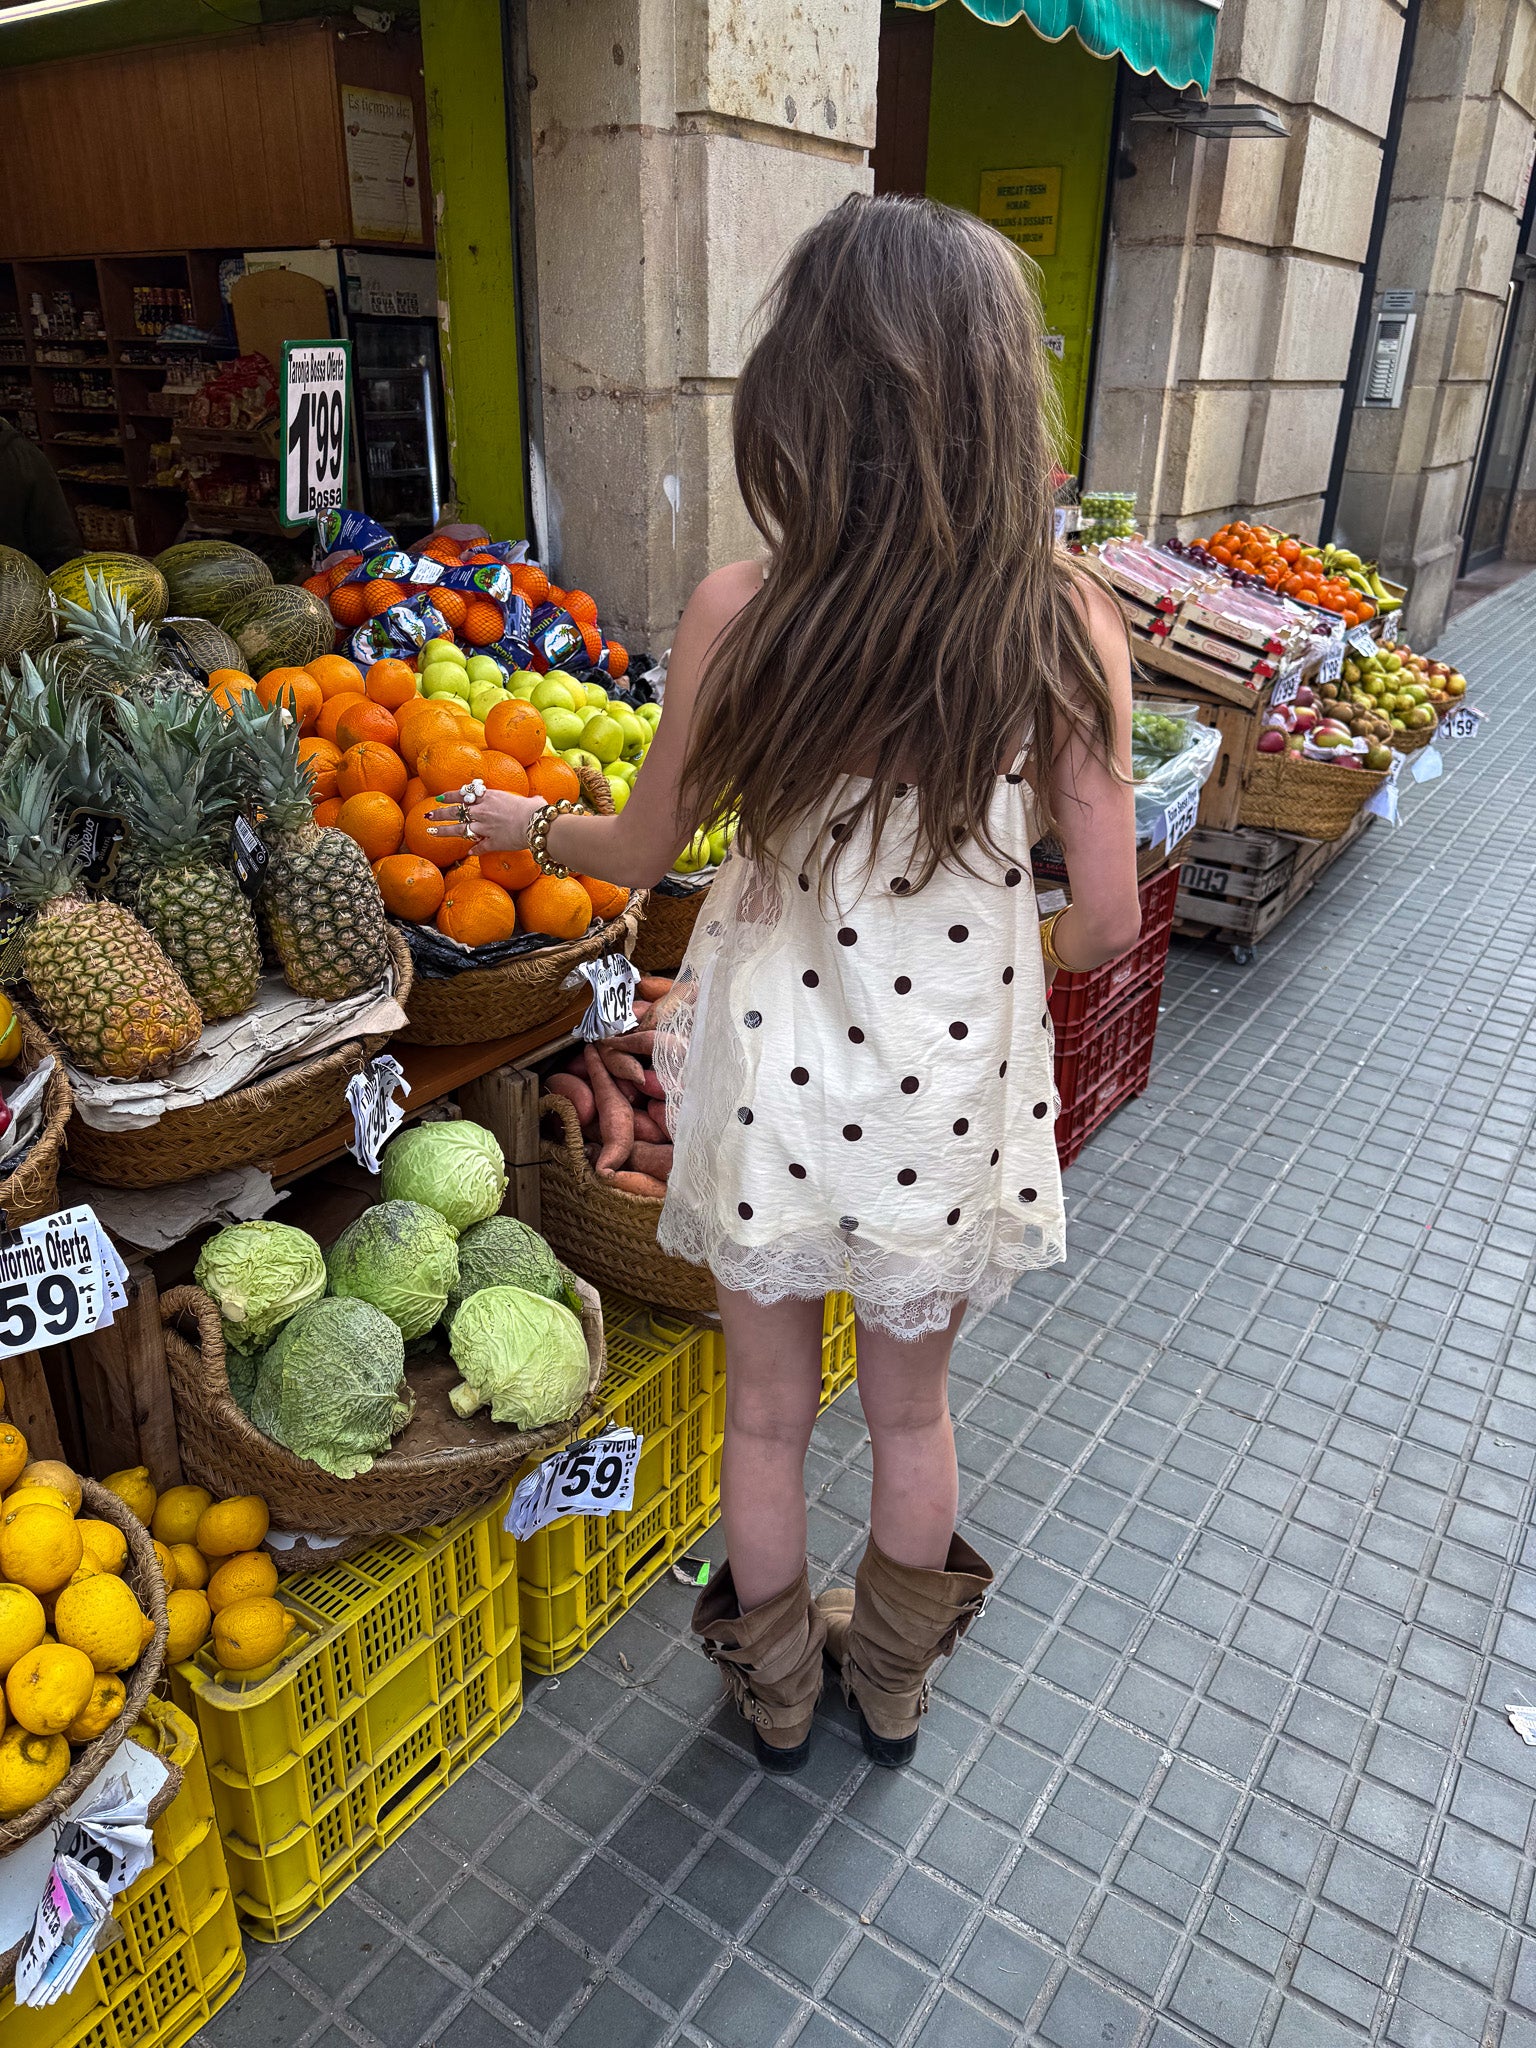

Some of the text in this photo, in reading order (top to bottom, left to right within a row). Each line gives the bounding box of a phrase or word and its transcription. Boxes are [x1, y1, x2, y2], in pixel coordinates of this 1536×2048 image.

[347, 93, 360, 110] Es
[361, 96, 394, 118] tiempo
[1025, 184, 1047, 195] FRESH
[288, 352, 344, 391] Taronja Bossa Oferta
[288, 390, 343, 513] 1'99
[309, 487, 342, 511] Bossa
[1445, 719, 1473, 737] 1'59
[1169, 805, 1194, 848] 1'25
[603, 982, 628, 1022] 1'29
[45, 1228, 92, 1270] Oferta
[77, 1265, 97, 1324] € Kilo
[619, 1452, 636, 1498] unitat
